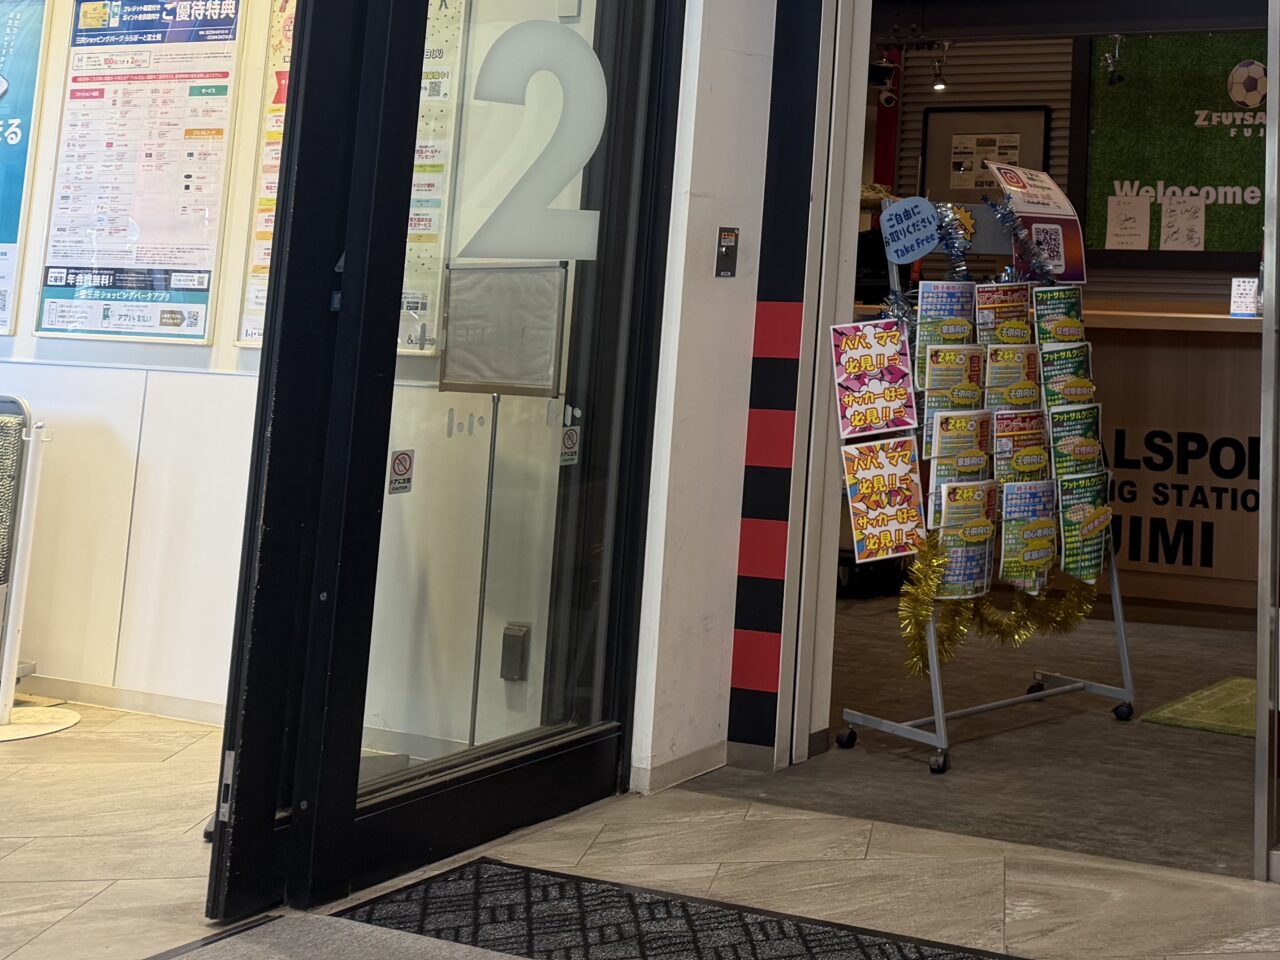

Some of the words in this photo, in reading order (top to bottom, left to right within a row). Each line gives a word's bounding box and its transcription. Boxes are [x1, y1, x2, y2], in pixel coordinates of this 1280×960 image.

[162, 0, 236, 21] ご優待特典
[457, 19, 608, 261] 2
[886, 204, 922, 228] ご自由に
[893, 243, 915, 259] Take
[916, 234, 935, 250] Free
[840, 331, 901, 351] パパ、ママ
[843, 387, 908, 407] サッカー好き
[853, 451, 911, 472] パパ、ママ
[857, 508, 919, 529] サッカー好き
